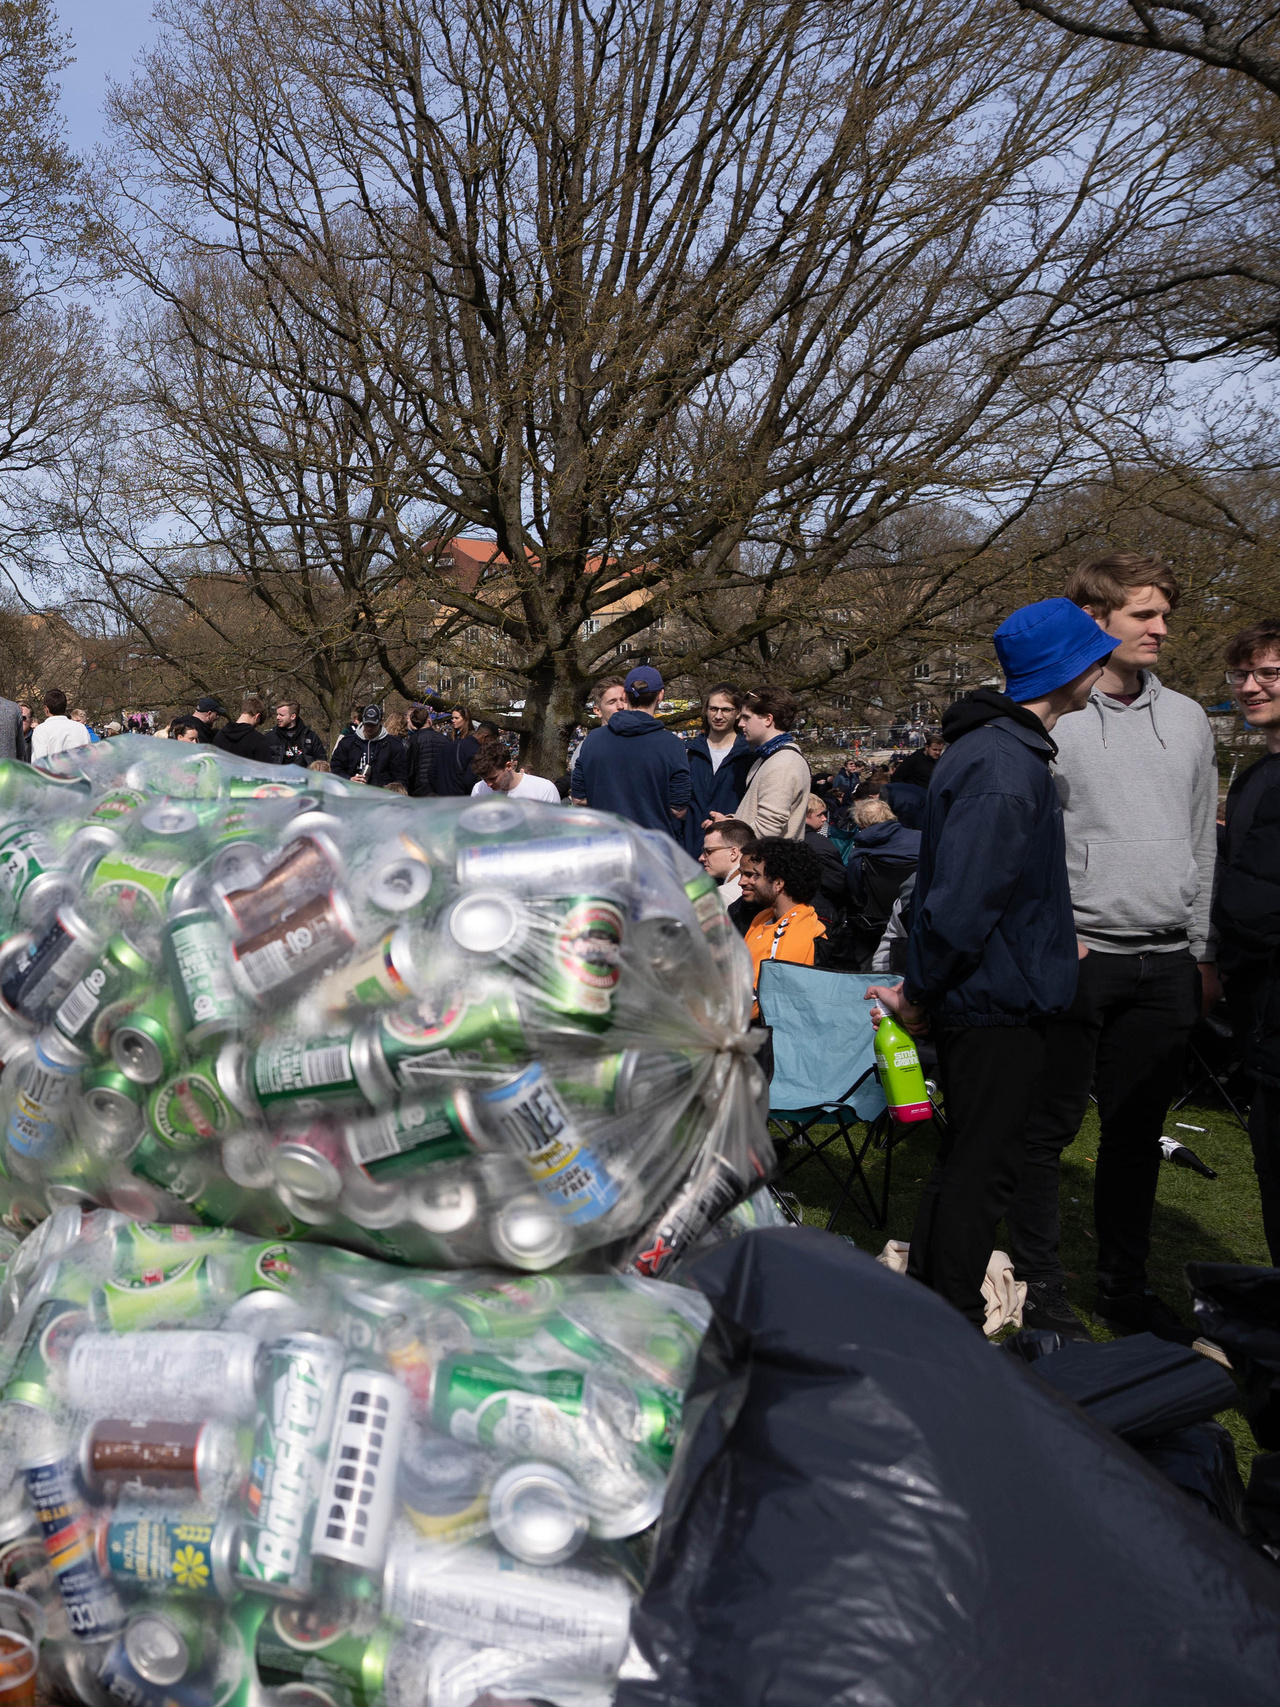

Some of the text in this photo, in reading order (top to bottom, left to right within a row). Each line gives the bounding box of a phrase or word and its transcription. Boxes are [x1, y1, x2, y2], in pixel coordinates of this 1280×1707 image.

[893, 1048, 917, 1060] SMÅ
[562, 1170, 594, 1198] FREE
[256, 1363, 320, 1575] Booster
